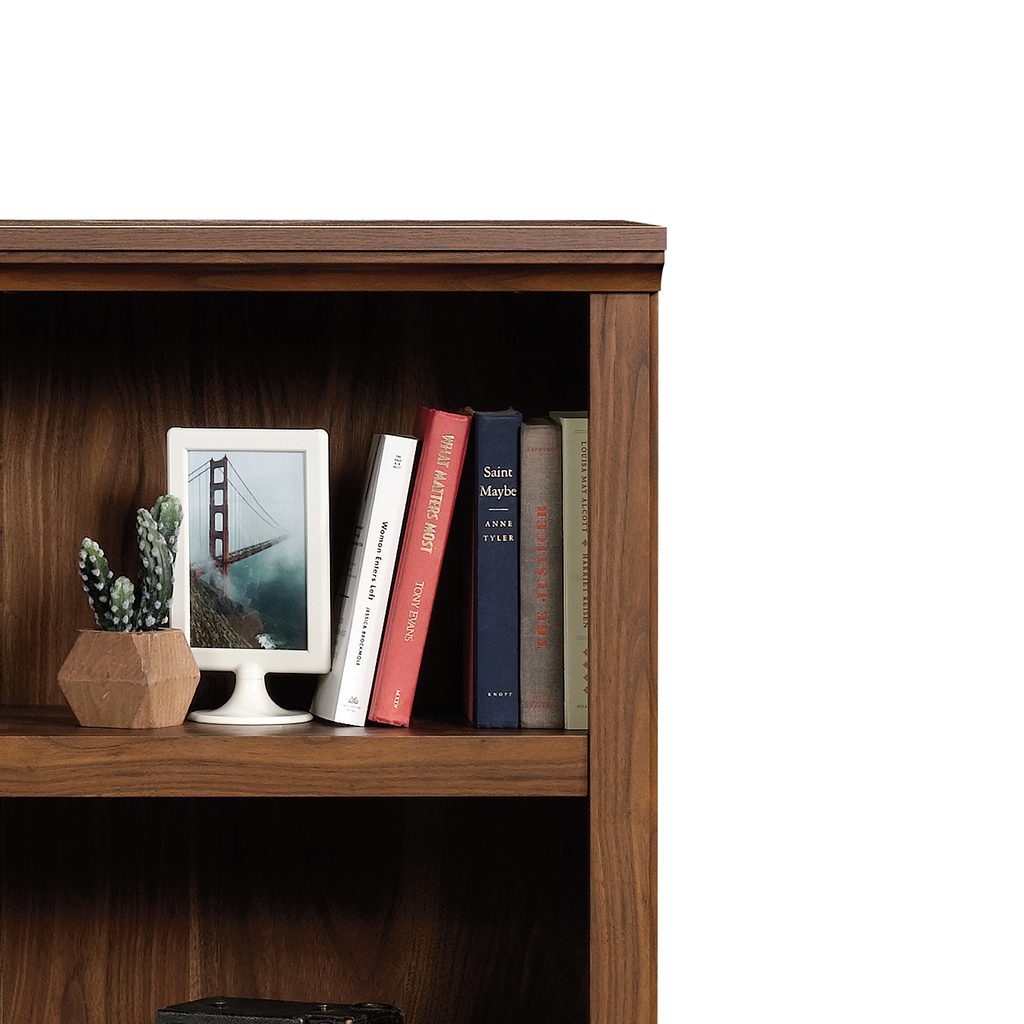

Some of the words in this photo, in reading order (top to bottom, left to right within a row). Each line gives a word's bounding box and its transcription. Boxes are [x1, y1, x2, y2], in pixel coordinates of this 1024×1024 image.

[436, 434, 455, 468] WHAT
[580, 441, 588, 473] LOUISA
[483, 466, 513, 478] Saint
[426, 470, 448, 521] MATTERS
[479, 485, 517, 500] Maybe
[375, 521, 389, 554] Woman
[420, 522, 437, 554] MOST
[482, 534, 515, 542] TYLER
[484, 520, 513, 528] ANNE
[371, 556, 383, 582] Enters
[367, 584, 377, 601] Left
[410, 581, 425, 609] TONY
[404, 610, 419, 642] EVANS
[536, 610, 548, 650] THE
